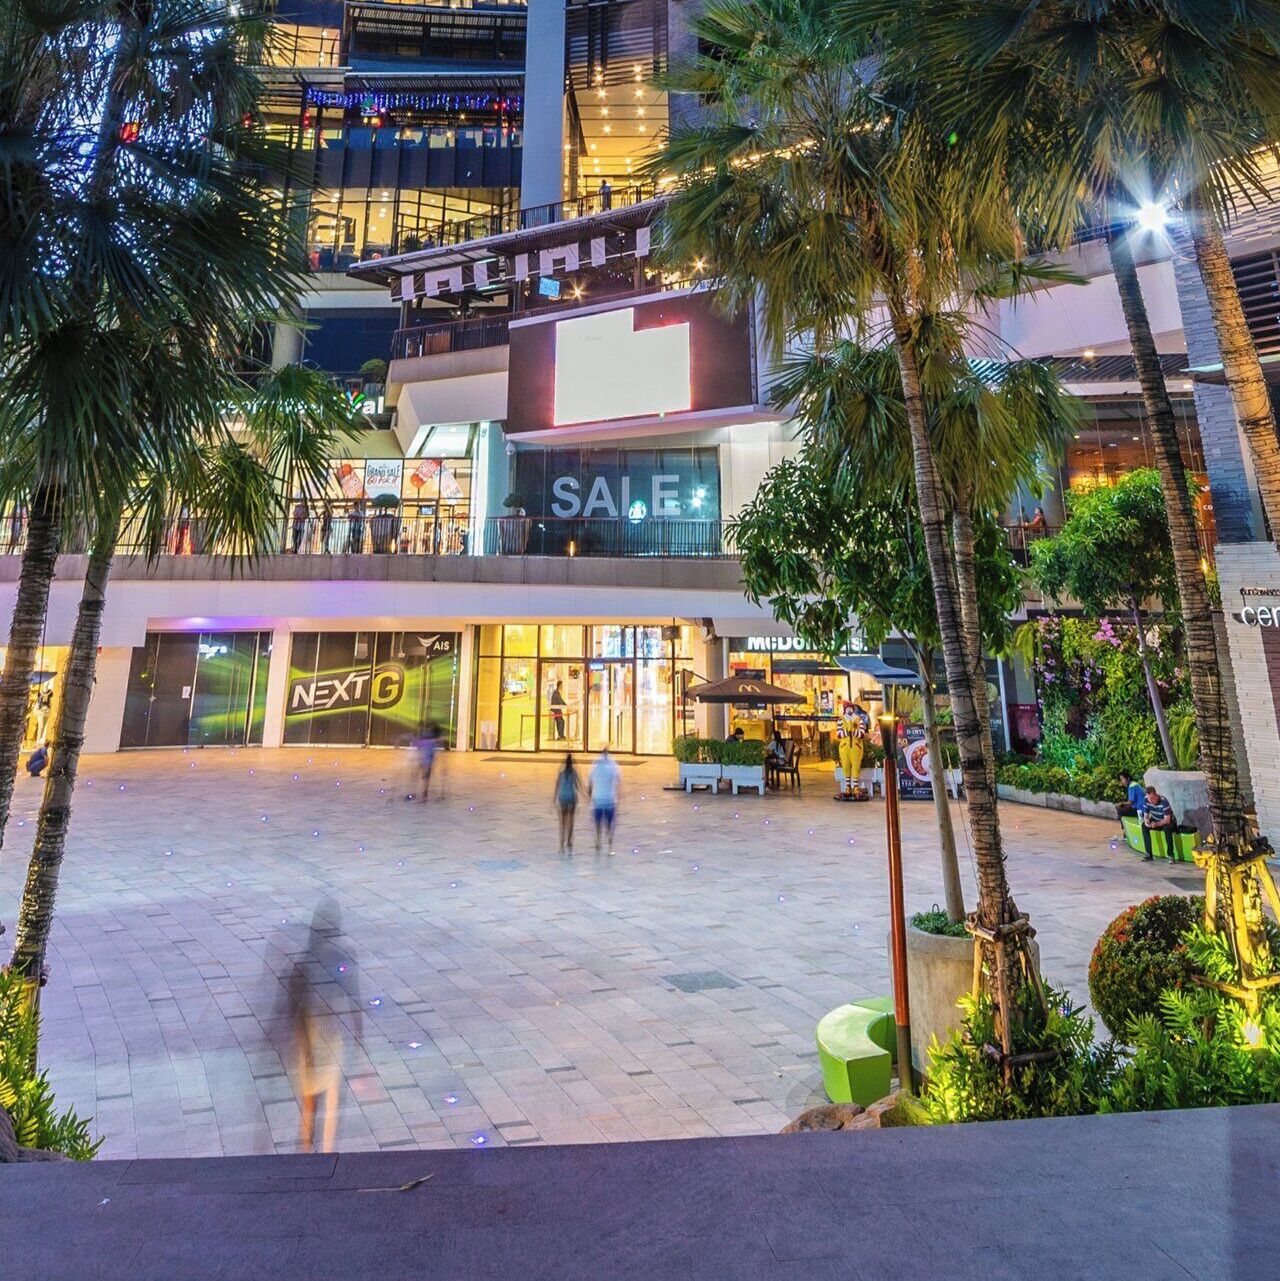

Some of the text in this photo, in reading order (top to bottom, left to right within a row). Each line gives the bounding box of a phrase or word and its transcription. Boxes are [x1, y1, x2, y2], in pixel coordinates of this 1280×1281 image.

[387, 464, 401, 477] SALE
[551, 474, 682, 518] SALE
[433, 641, 450, 651] AIS
